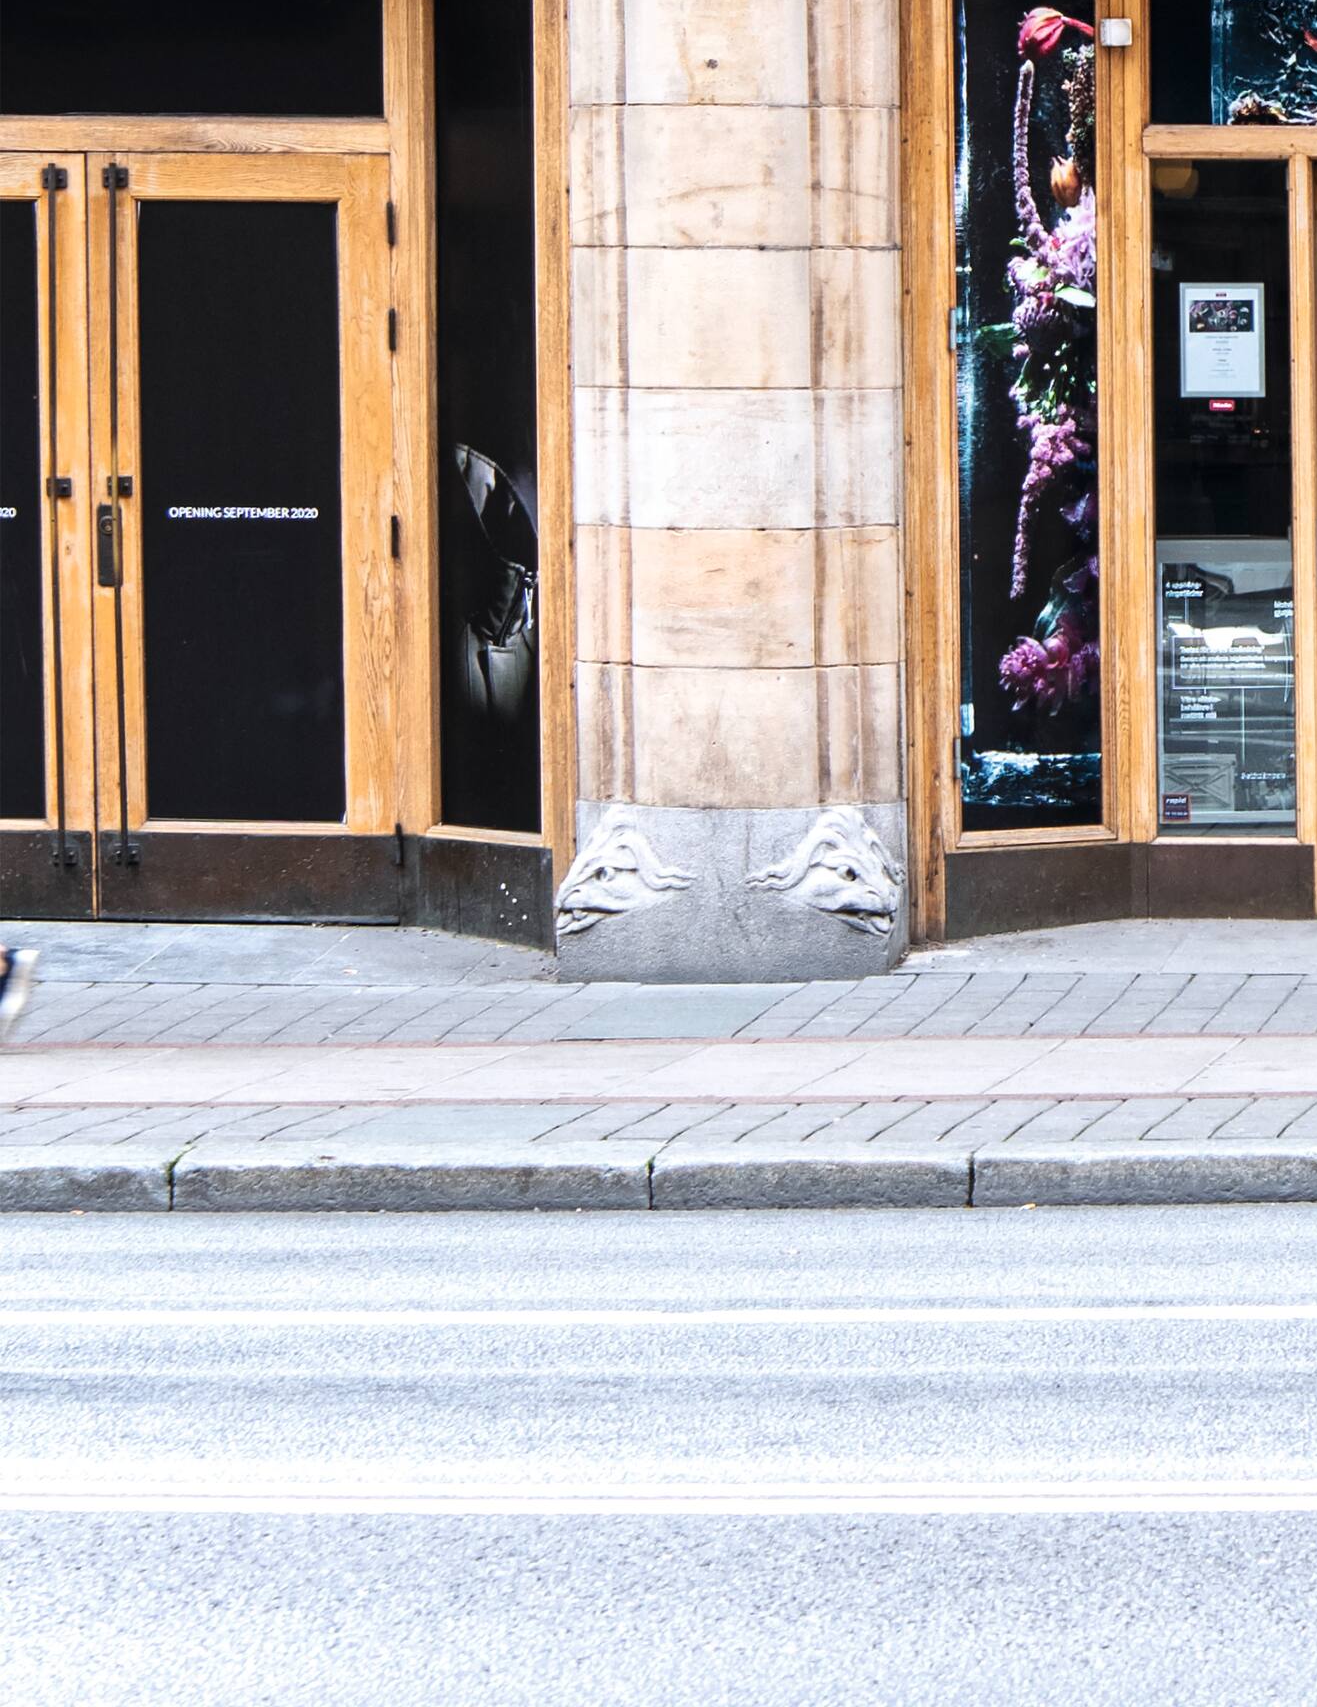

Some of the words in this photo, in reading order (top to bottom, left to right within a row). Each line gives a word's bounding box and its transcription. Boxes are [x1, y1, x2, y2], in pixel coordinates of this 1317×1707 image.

[169, 506, 222, 519] OPENING
[223, 506, 290, 519] SEPTEMBER
[291, 507, 319, 519] 2020
